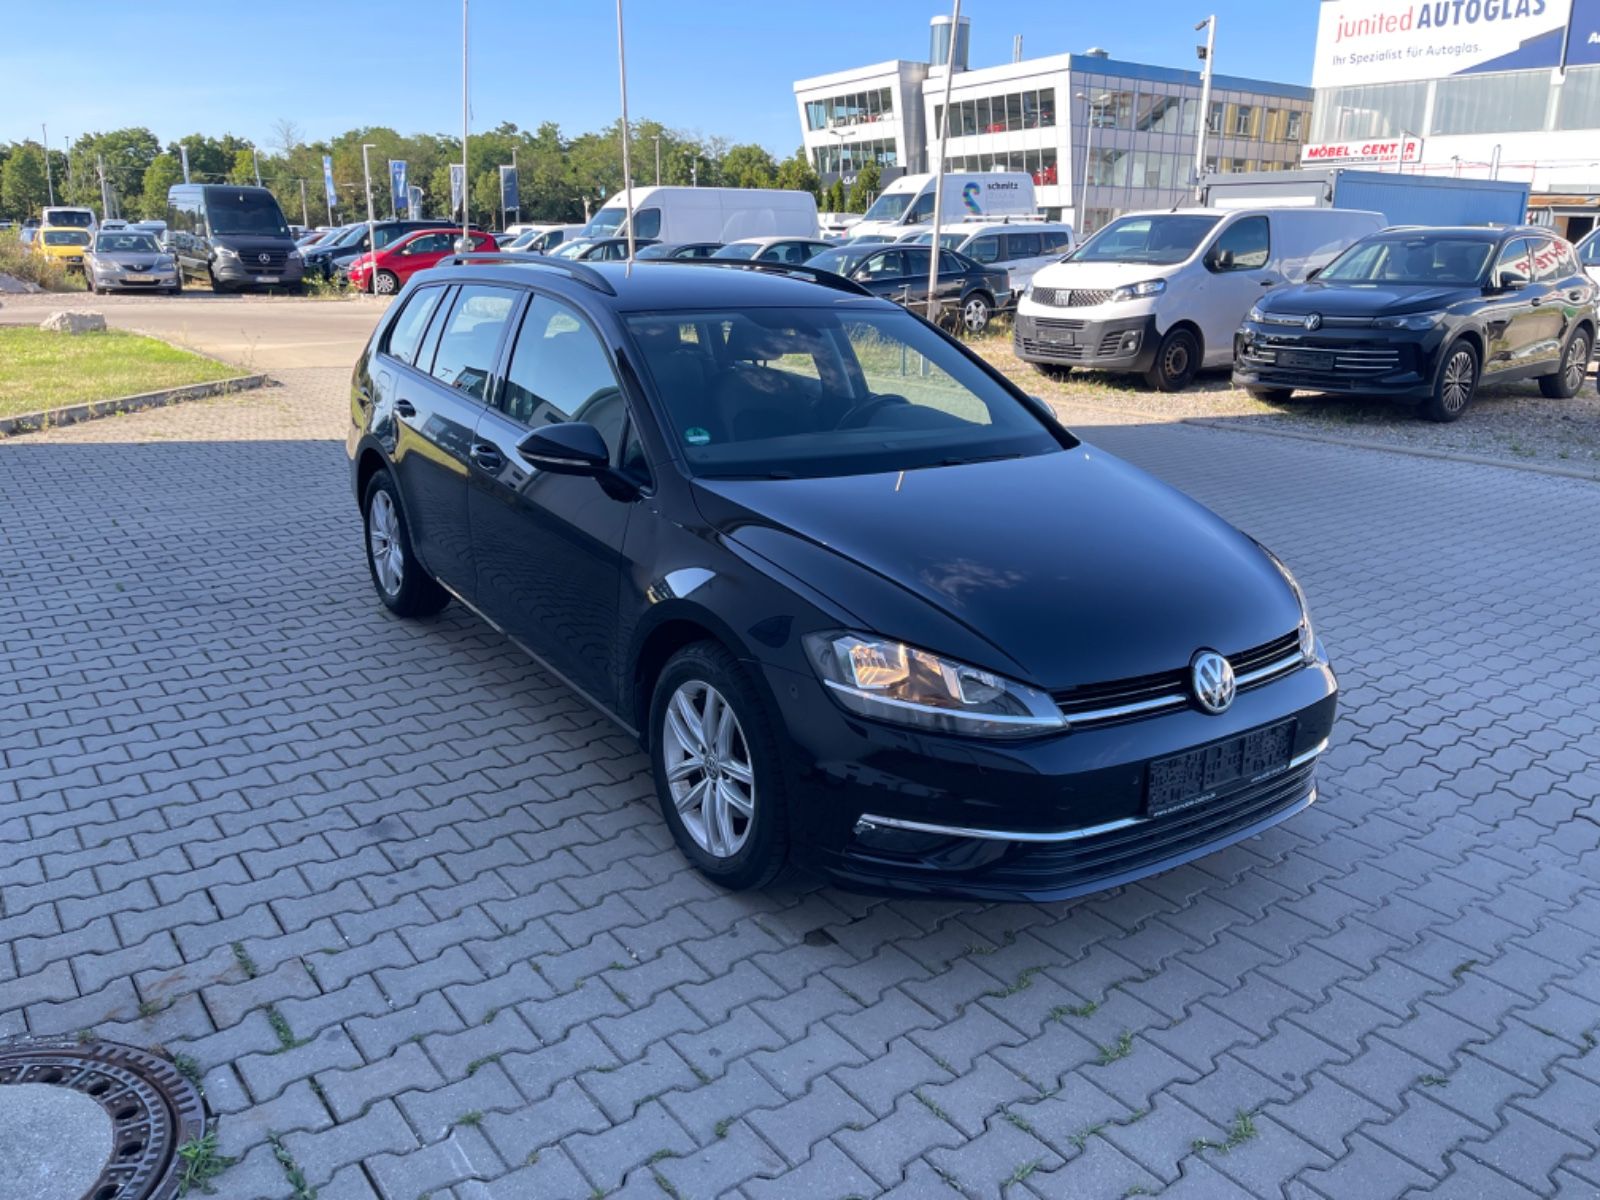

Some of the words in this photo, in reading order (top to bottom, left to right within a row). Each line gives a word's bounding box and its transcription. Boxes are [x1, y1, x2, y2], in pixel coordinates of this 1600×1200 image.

[1335, 5, 1413, 44] junited
[1416, 0, 1546, 29] AUTOGLAS
[1332, 54, 1346, 66] Ihr
[1349, 48, 1402, 66] Spezialist
[1406, 45, 1423, 59] für
[1426, 42, 1482, 57] Autoglas.
[1308, 144, 1350, 158] MÖBEL
[1361, 142, 1415, 155] CENTR
[987, 181, 1018, 190] schmitz
